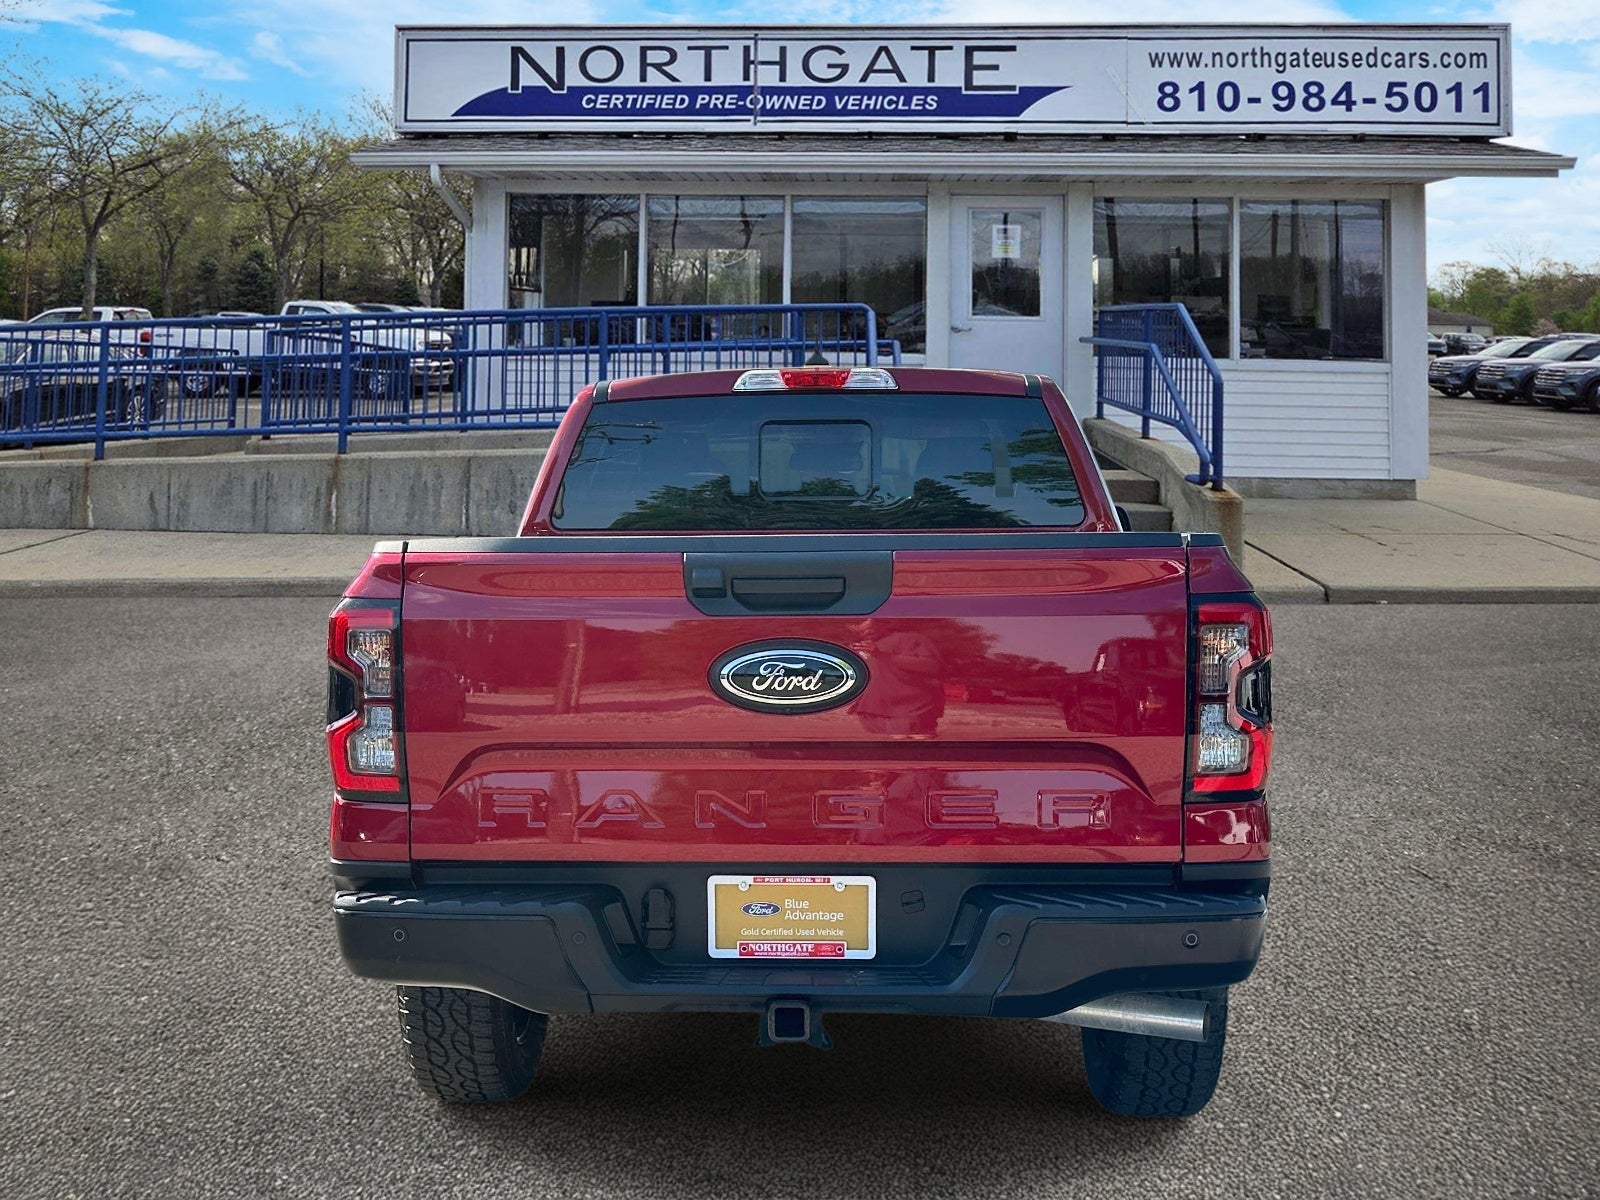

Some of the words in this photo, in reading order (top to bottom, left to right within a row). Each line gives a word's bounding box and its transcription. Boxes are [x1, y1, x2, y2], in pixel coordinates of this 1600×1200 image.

[1148, 46, 1489, 73] www.northgateusedcars.com
[509, 44, 1018, 95] NORTHGATE
[581, 94, 690, 110] CERTIFIED
[695, 94, 829, 111] PRE-OWNED
[834, 95, 939, 111] VEHICLES
[1156, 80, 1491, 113] 810-984-5011
[751, 661, 824, 691] Ford
[476, 788, 1113, 830] RANGER
[748, 903, 774, 915] Ford
[784, 898, 810, 909] Blue
[784, 909, 844, 922] Advantage
[740, 928, 759, 936] Gold
[761, 928, 793, 936] Certified
[795, 928, 815, 936] Used
[817, 928, 844, 936] Vehicle
[748, 943, 814, 952] NORTHGATE
